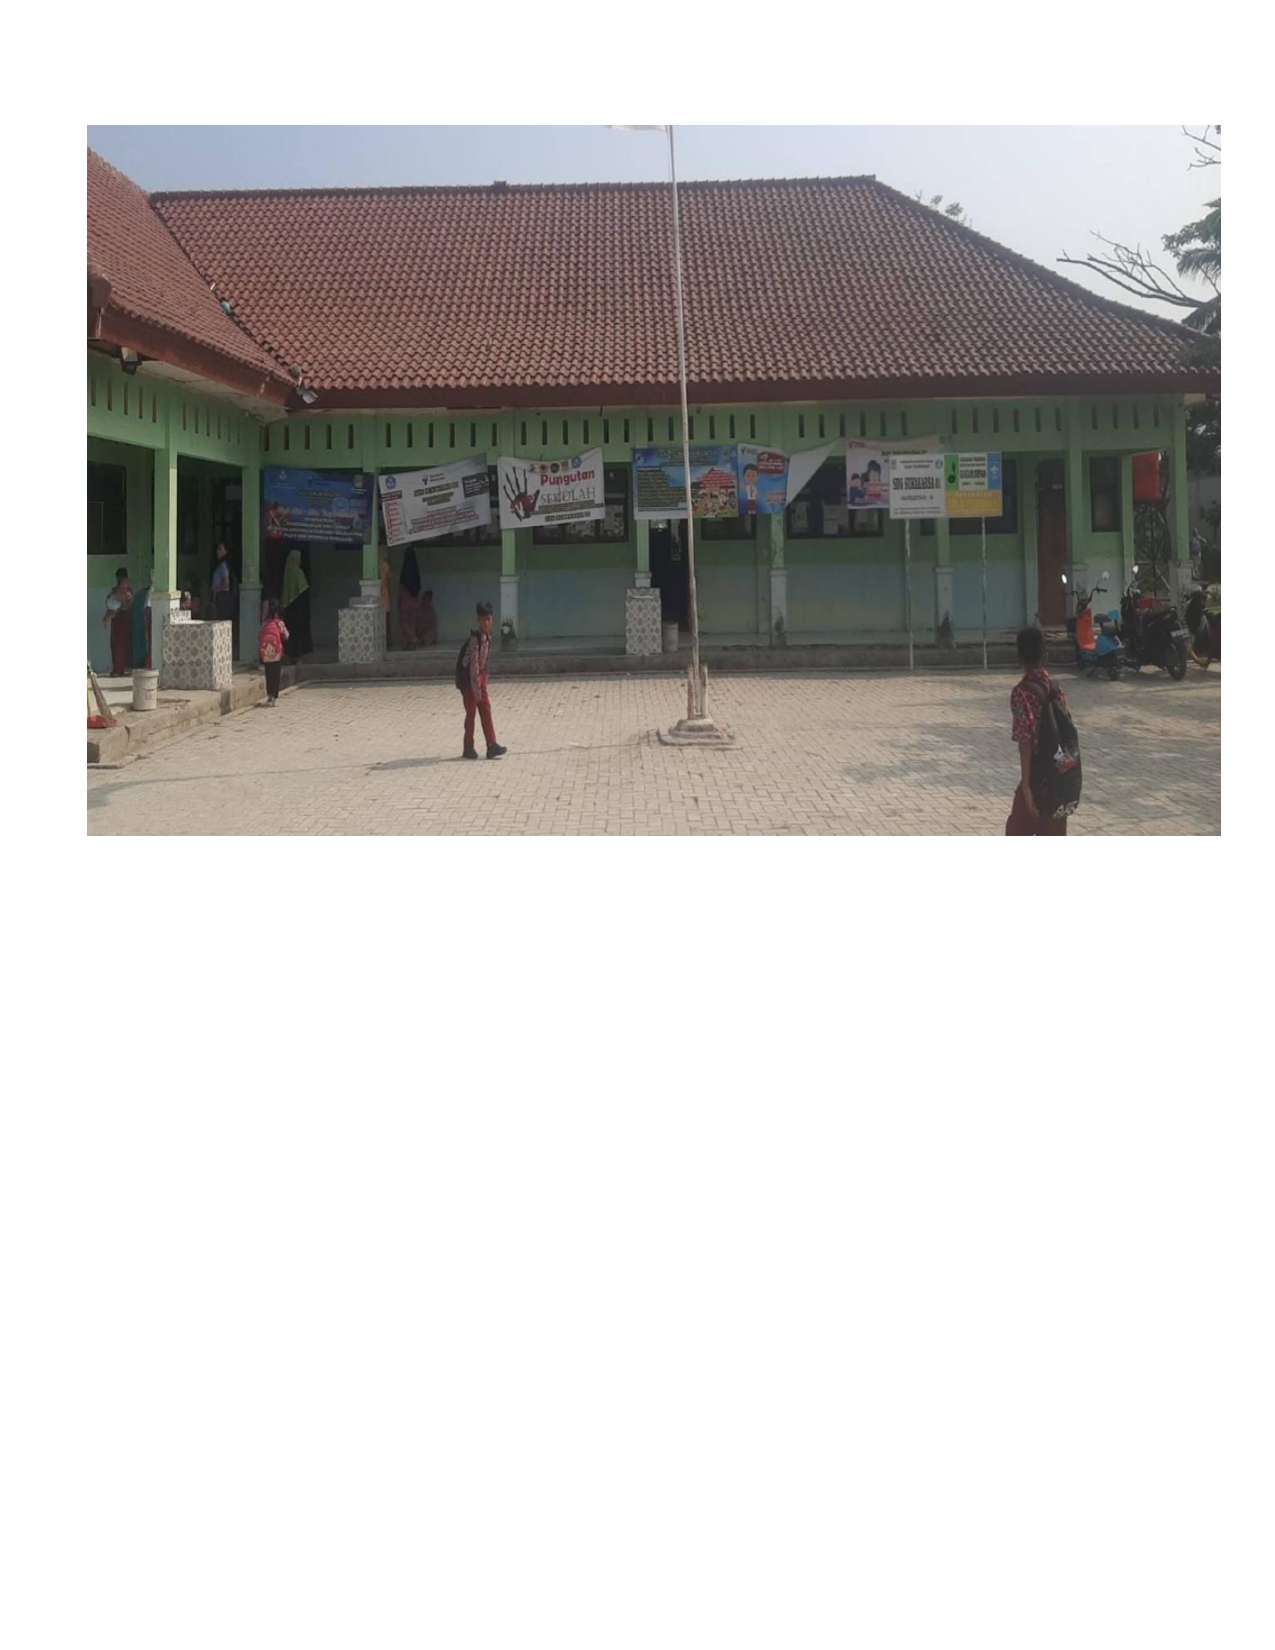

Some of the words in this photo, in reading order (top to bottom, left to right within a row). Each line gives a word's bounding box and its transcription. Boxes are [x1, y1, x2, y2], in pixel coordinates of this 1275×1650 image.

[540, 470, 595, 486] Pungutan
[892, 478, 903, 490] SDN
[905, 476, 934, 490] SUKAKARSA
[540, 486, 596, 504] SEKOLAH
